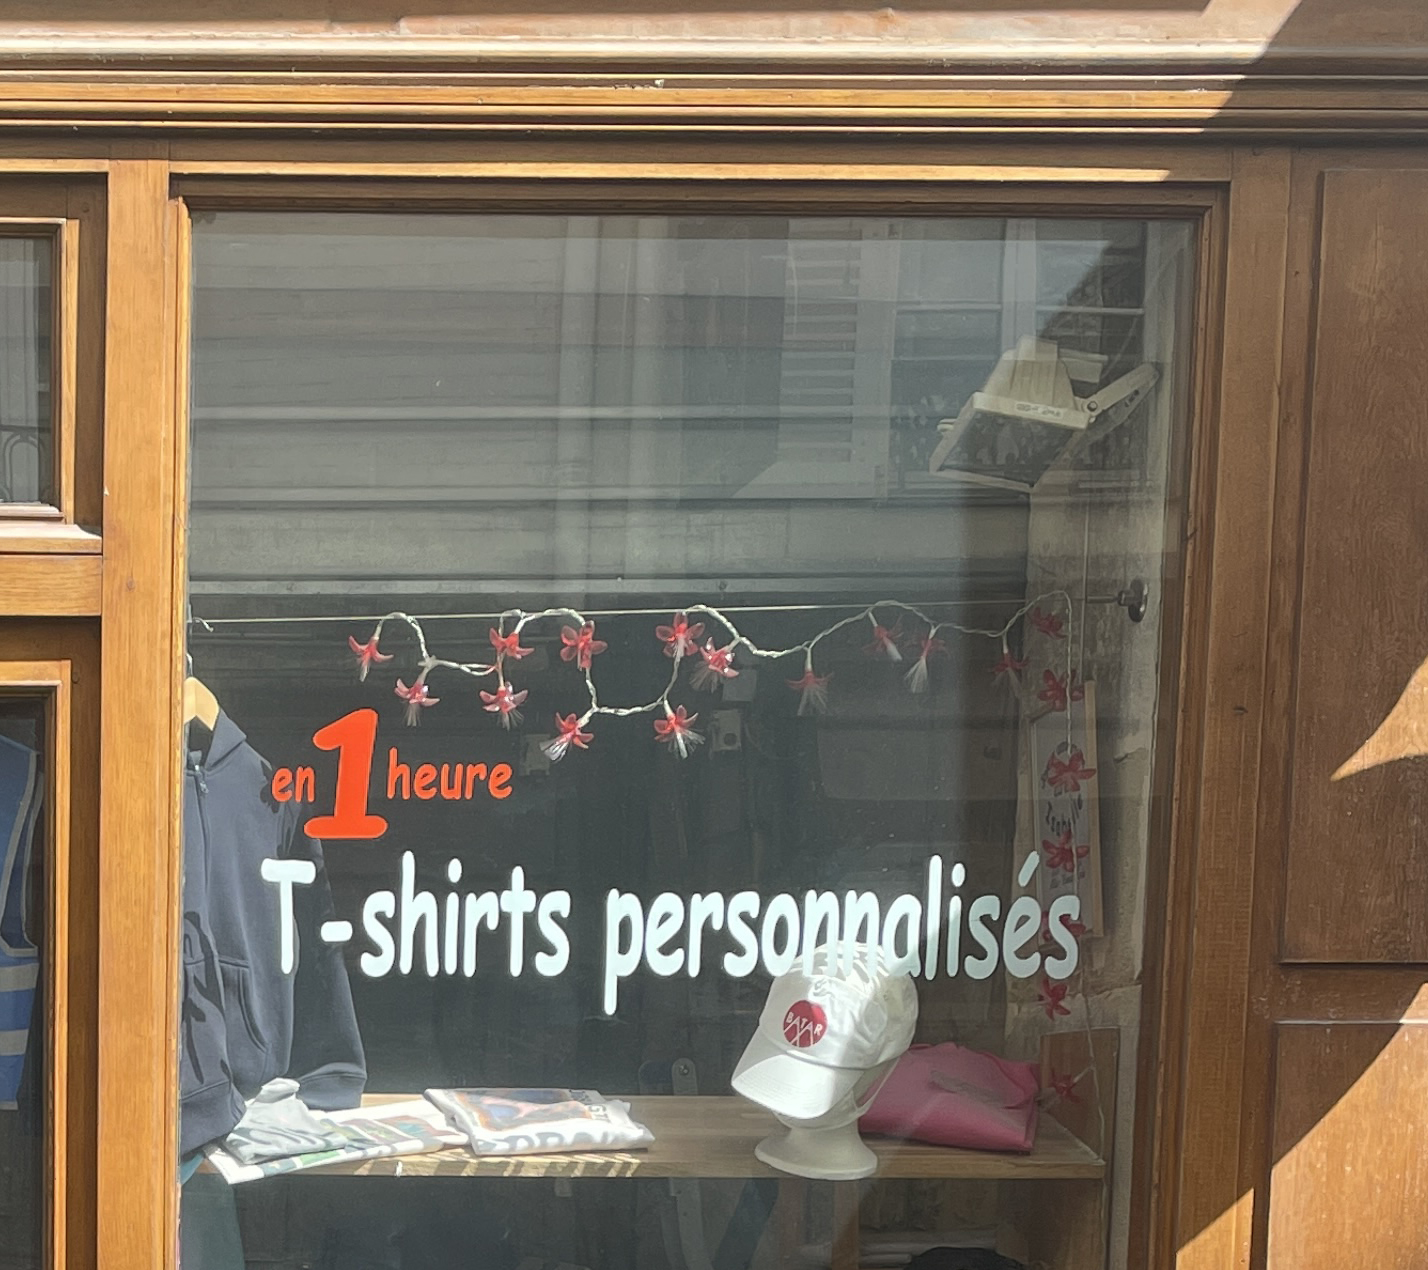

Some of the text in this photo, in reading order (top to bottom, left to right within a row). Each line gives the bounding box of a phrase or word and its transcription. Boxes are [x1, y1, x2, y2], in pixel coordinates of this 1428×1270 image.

[271, 707, 513, 839] en 1 heure
[260, 850, 1082, 1015] T-shirts personnalisés
